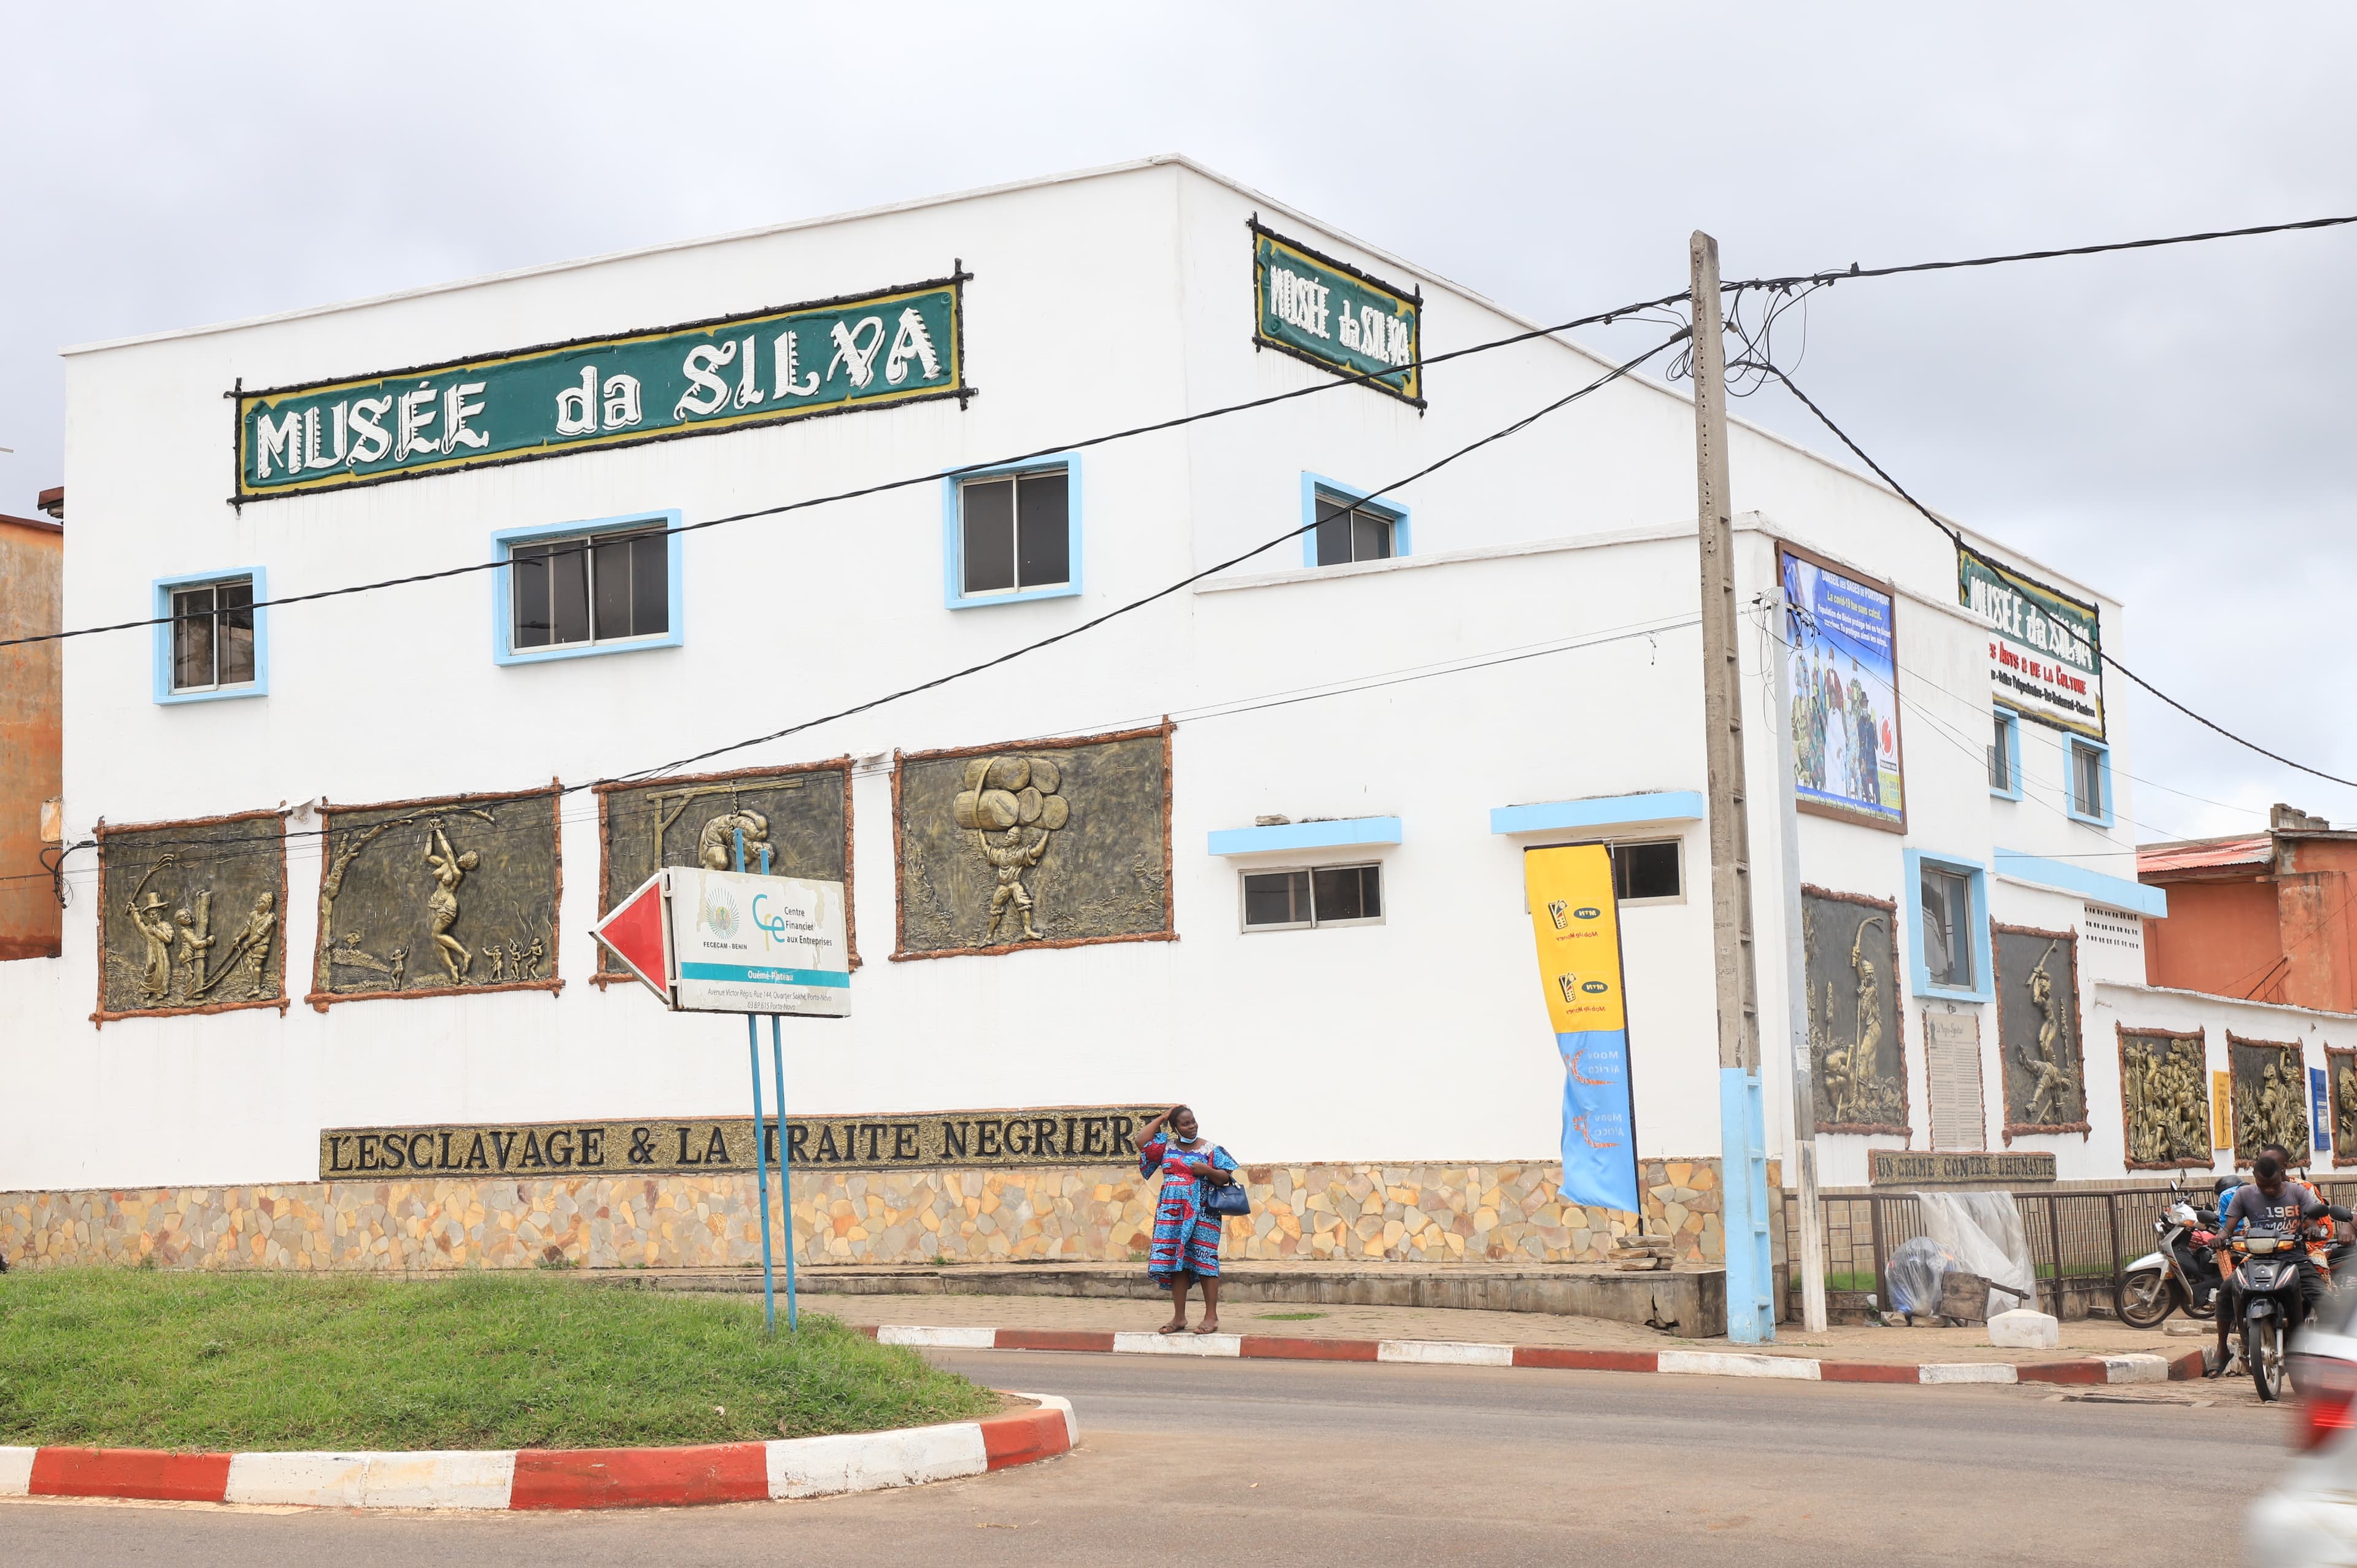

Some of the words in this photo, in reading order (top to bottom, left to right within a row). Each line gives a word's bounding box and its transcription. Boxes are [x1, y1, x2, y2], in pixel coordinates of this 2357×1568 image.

[1270, 265, 1330, 339] MUSÉE
[1339, 299, 1360, 352] da
[1360, 306, 1411, 372] SILVA
[257, 380, 490, 480] MUSÉE
[555, 366, 642, 436] da
[674, 307, 942, 422] SILVA
[1827, 590, 1832, 601] La
[1858, 604, 1868, 615] sans
[1817, 604, 1836, 617] Population
[1970, 576, 2023, 639] MUSÉE
[2026, 604, 2047, 651] da
[2021, 657, 2028, 673] &
[784, 906, 805, 917] Centre
[785, 920, 814, 931] Financier
[799, 935, 832, 946] Entreprises
[748, 970, 793, 981] Ouémé-Plateau
[773, 991, 792, 1000] Quartier
[807, 993, 832, 1002] Porto-Novo
[770, 1002, 796, 1011] Porto-Novo
[329, 1128, 605, 1172] L'ESCLAVAGE
[627, 1127, 655, 1164] &
[675, 1126, 731, 1164] LA
[754, 1123, 919, 1162] TRAITE
[1877, 1157, 1893, 1177] UN
[1898, 1157, 1934, 1177] CRIME
[1943, 1157, 1991, 1178] CONTRE
